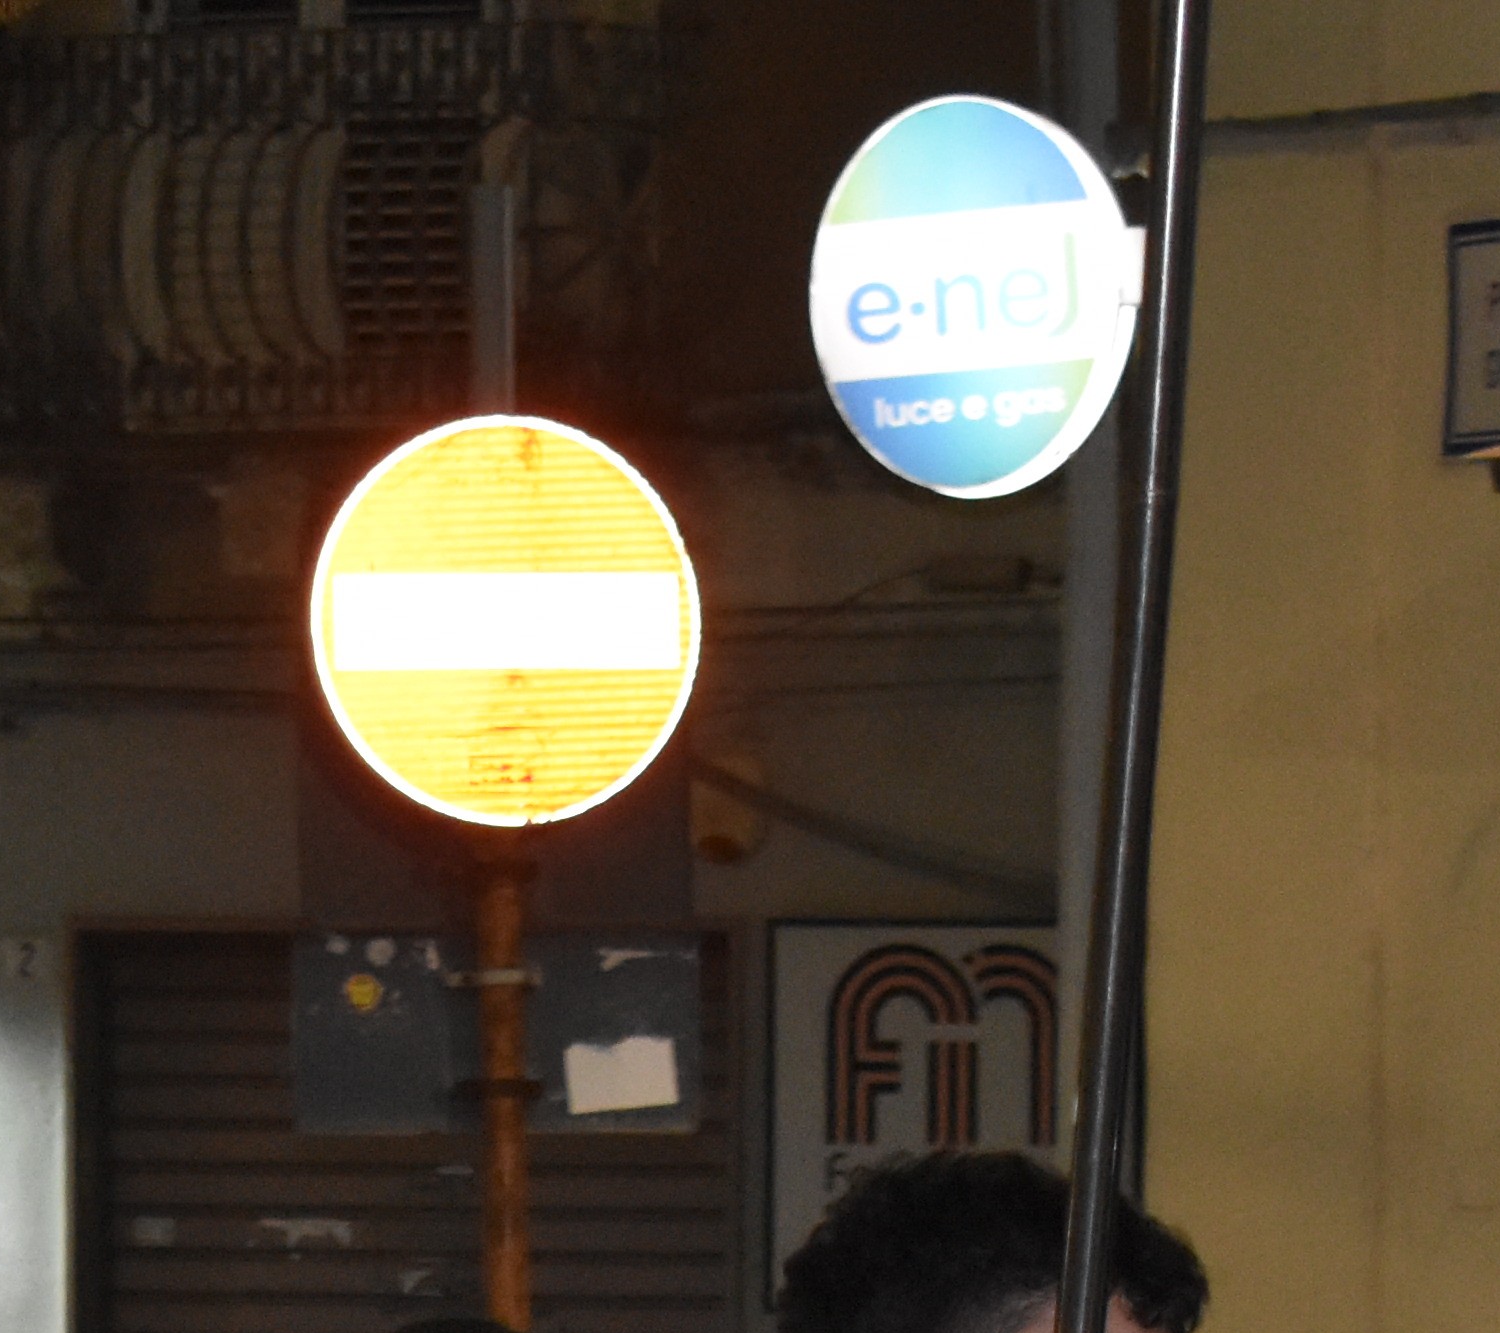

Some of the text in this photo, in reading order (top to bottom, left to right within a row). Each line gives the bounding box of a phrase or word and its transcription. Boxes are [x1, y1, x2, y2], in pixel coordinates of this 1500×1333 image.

[874, 385, 1068, 429] luce e gas
